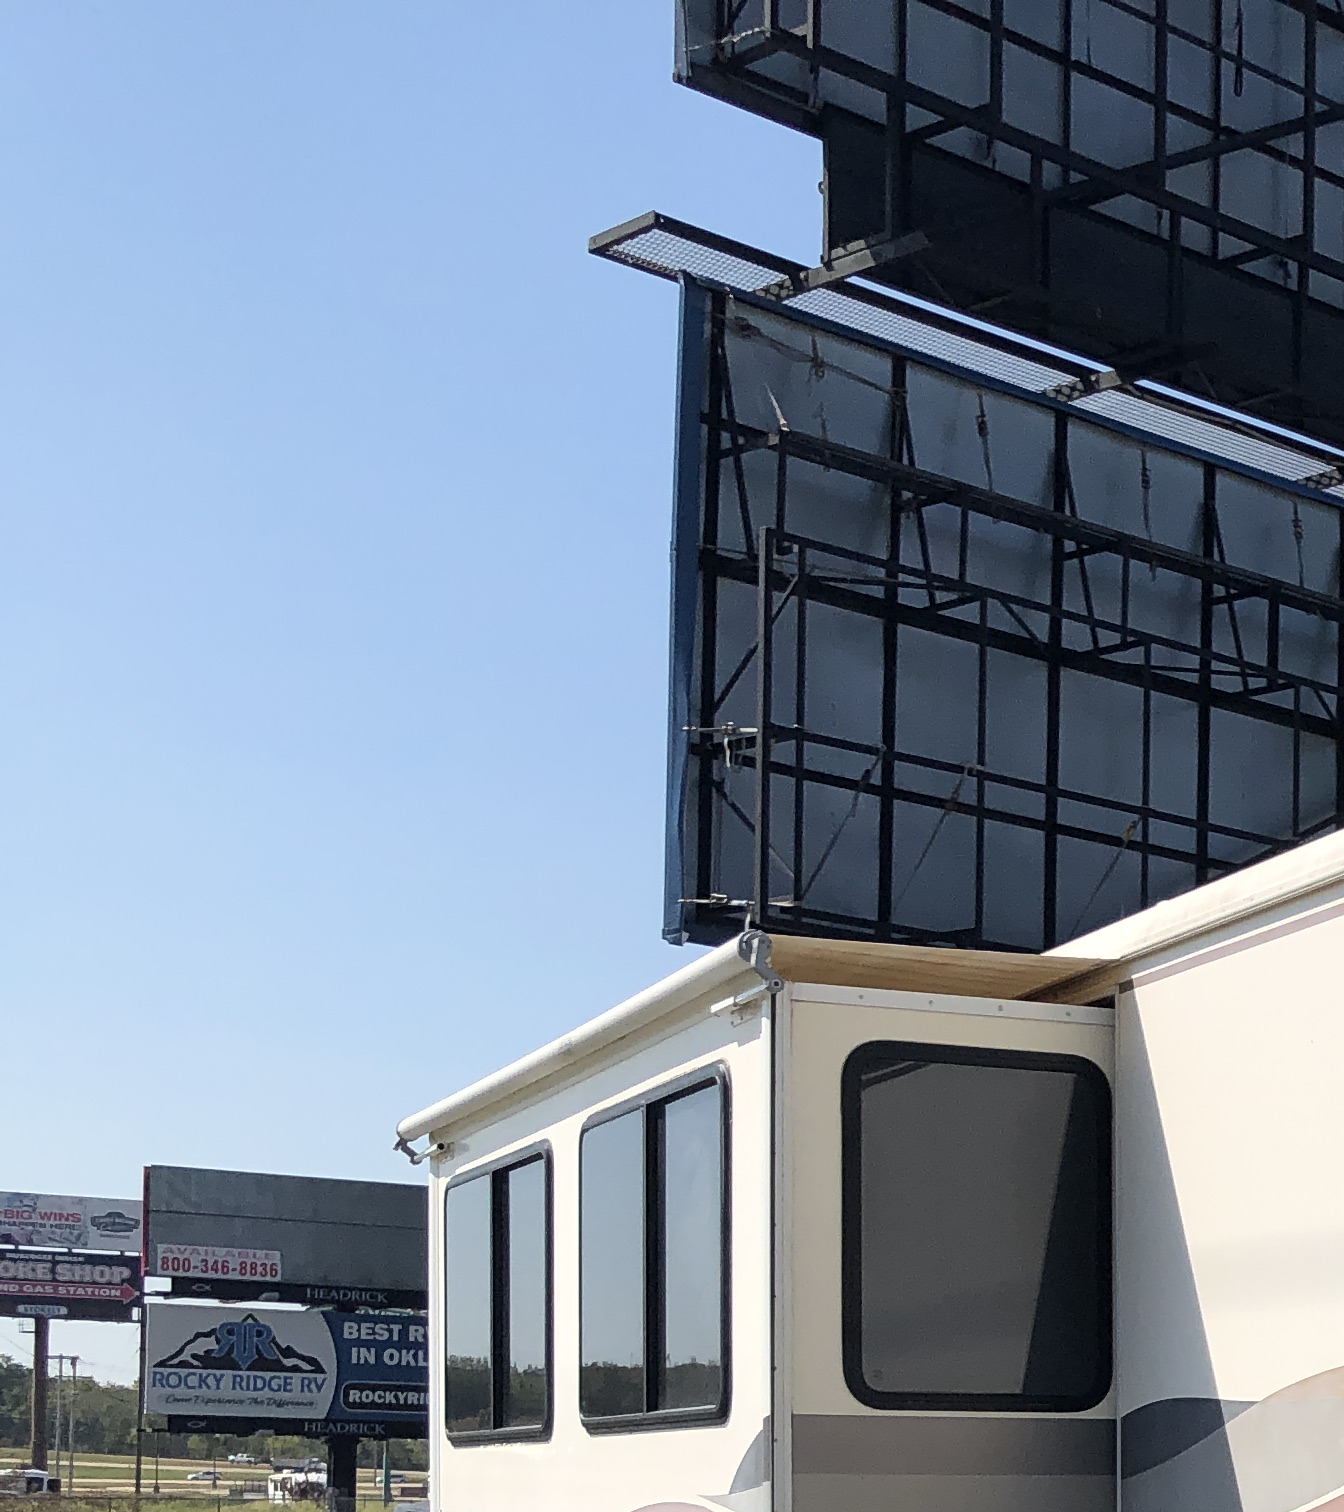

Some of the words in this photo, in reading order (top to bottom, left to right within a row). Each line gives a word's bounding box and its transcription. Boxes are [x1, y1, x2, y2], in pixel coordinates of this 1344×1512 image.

[4, 1209, 33, 1220] BIG
[39, 1211, 82, 1223] WINS
[55, 1263, 131, 1283] SHOP
[160, 1256, 279, 1278] 800-346-8836
[23, 1285, 54, 1293] GAS
[58, 1287, 121, 1296] STATION
[306, 1288, 388, 1303] HEADRICK
[343, 1321, 402, 1341] BEST
[408, 1325, 429, 1342] R
[351, 1347, 376, 1365] IN
[152, 1371, 226, 1391] ROCKY
[231, 1374, 294, 1393] RIDGE
[300, 1376, 328, 1394] RV
[348, 1389, 429, 1405] ROCKYRI
[303, 1421, 386, 1435] HEADRICK
